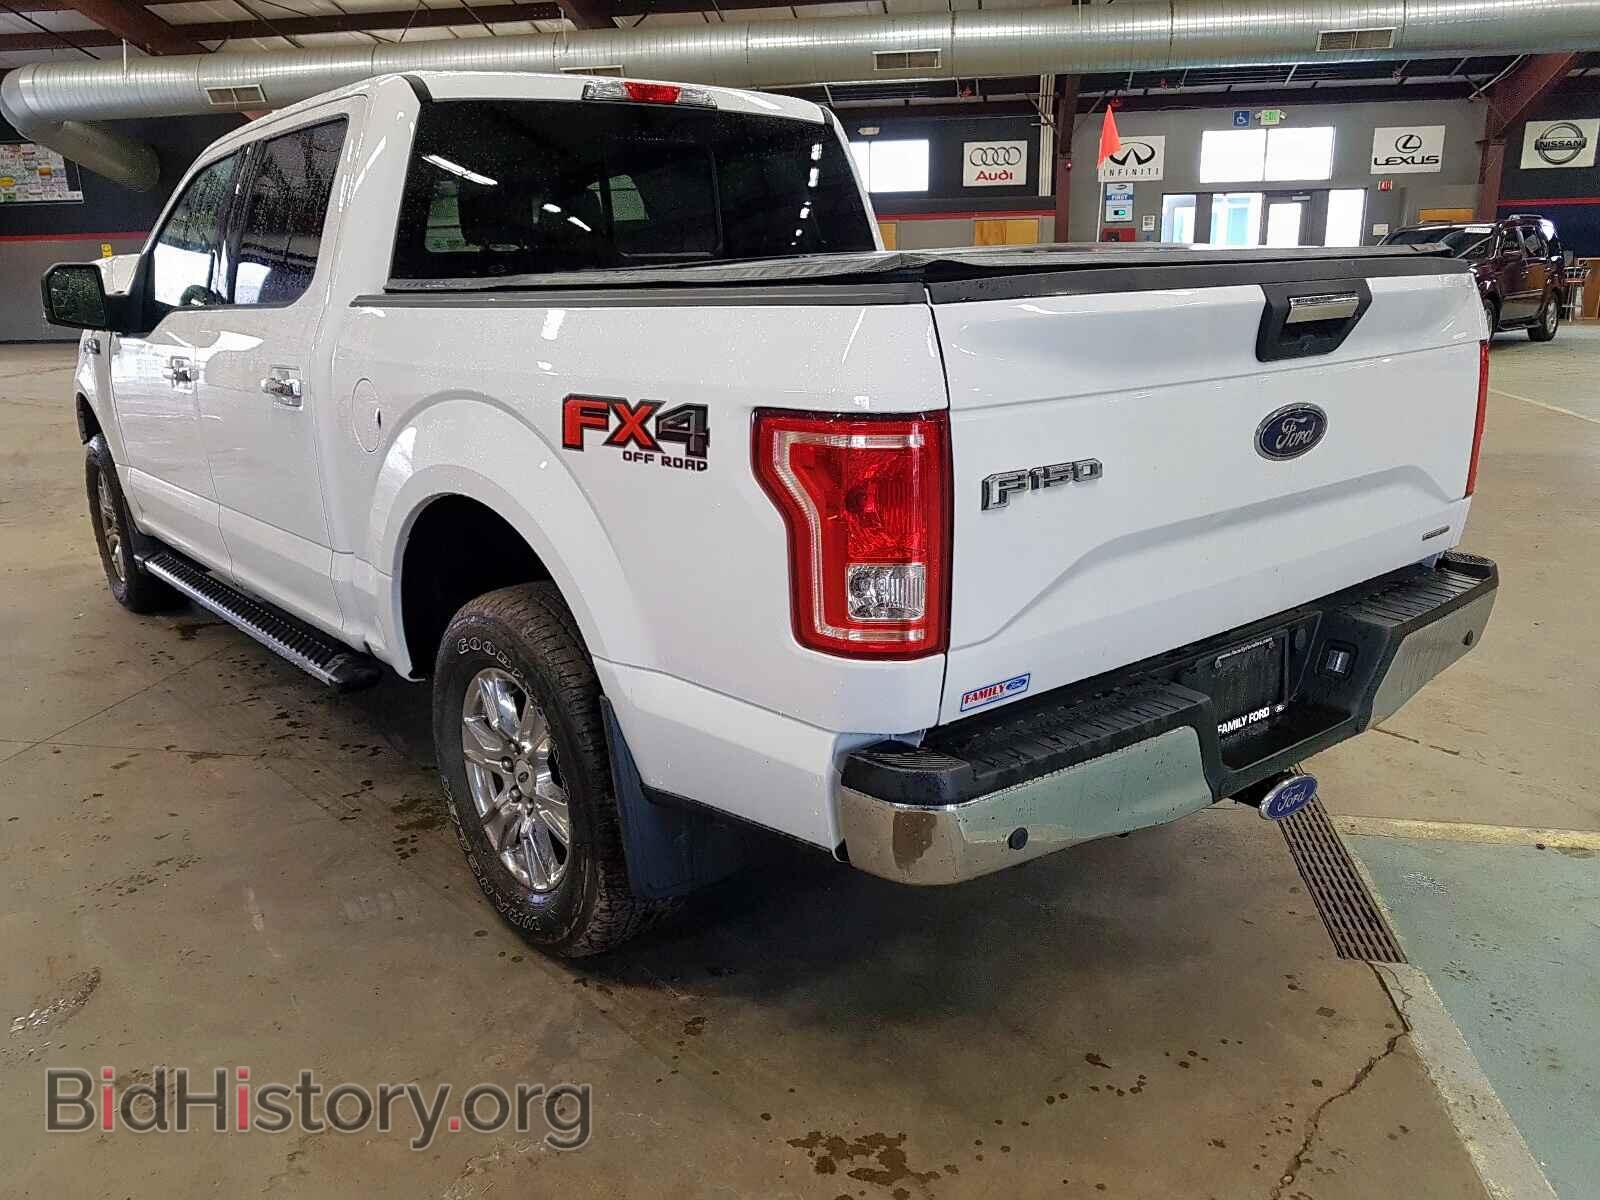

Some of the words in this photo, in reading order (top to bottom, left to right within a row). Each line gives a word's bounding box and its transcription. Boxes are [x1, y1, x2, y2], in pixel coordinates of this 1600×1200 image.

[1540, 139, 1583, 149] NISSAN
[1374, 155, 1439, 165] LEXUS
[975, 169, 1013, 181] Audi
[1103, 167, 1159, 177] INFINITI
[561, 393, 710, 460] FX4
[1275, 416, 1316, 450] Ford
[622, 451, 655, 464] OFF
[660, 455, 708, 472] ROAD
[965, 683, 1006, 705] FAMILY
[1217, 715, 1248, 734] FAMILY
[1248, 706, 1270, 724] FORD
[1277, 783, 1308, 812] Ford
